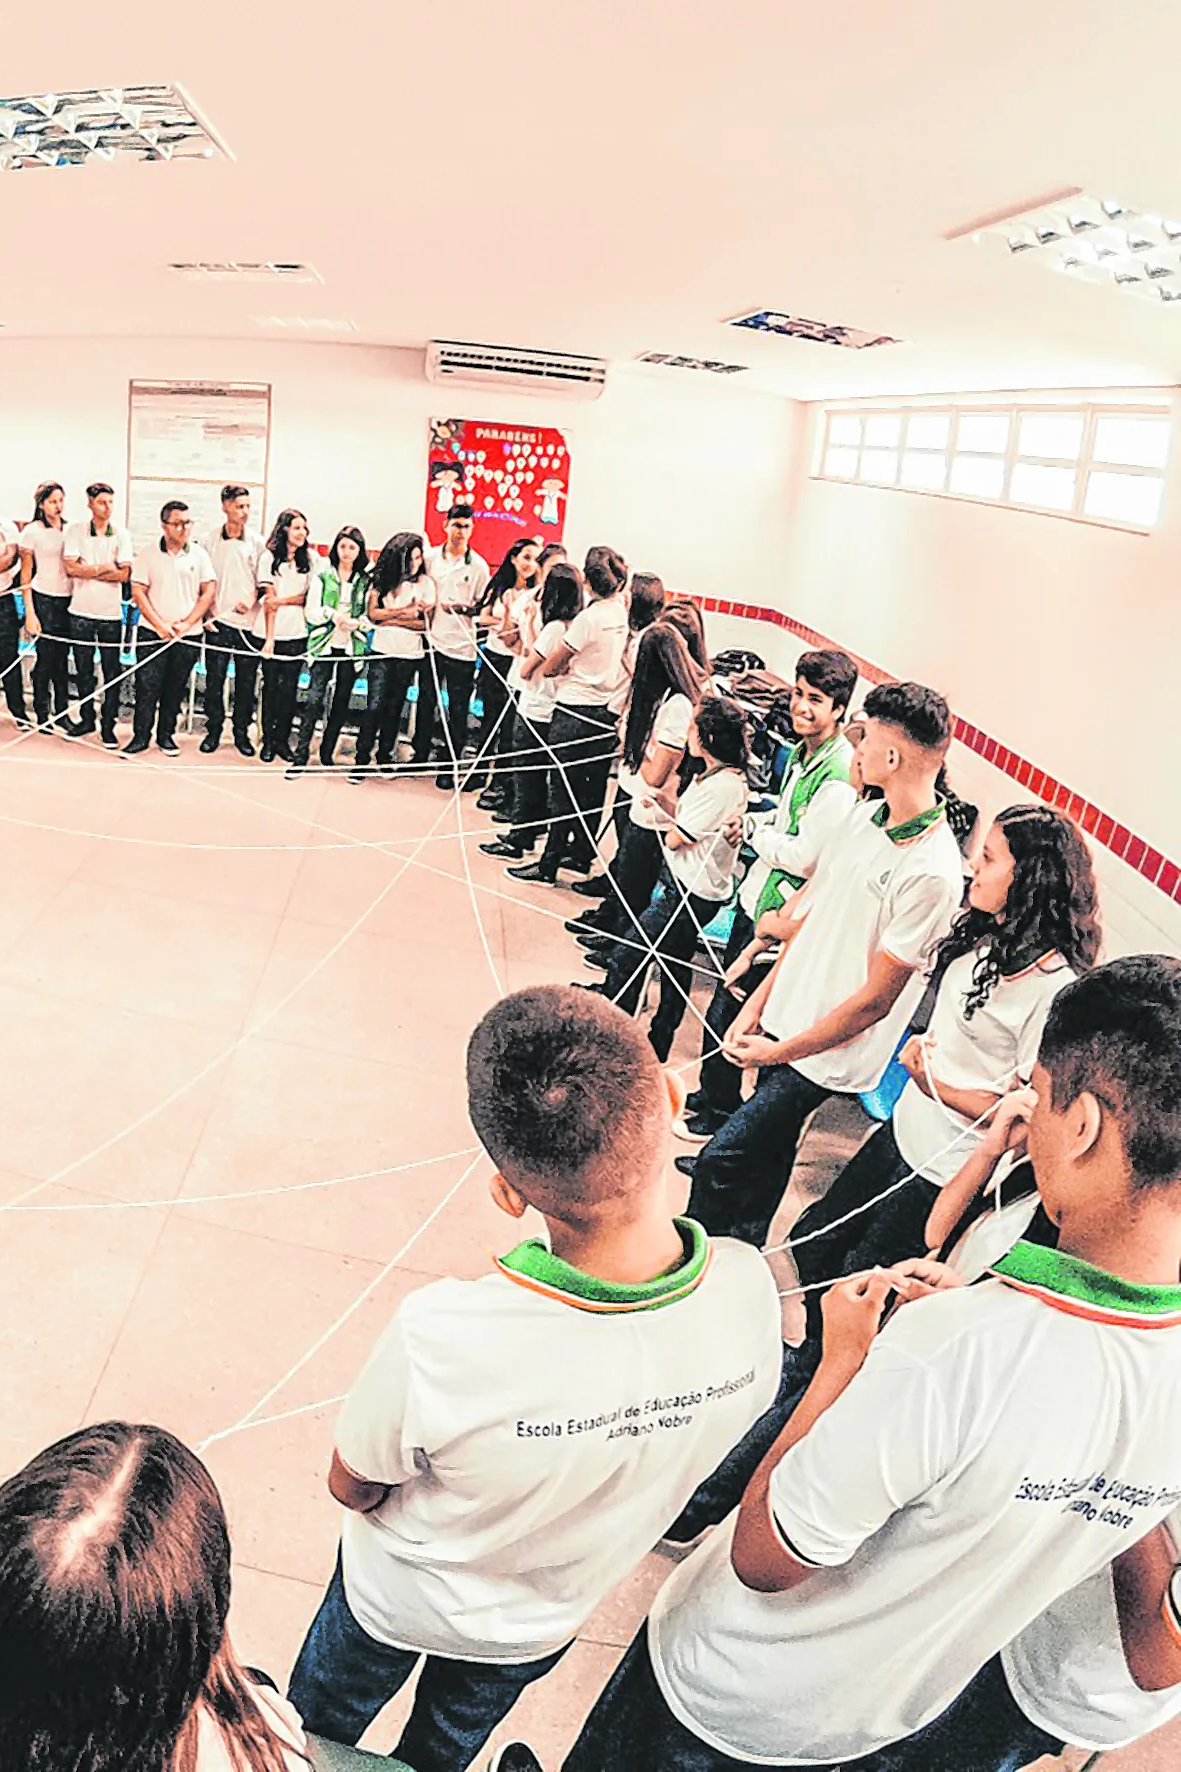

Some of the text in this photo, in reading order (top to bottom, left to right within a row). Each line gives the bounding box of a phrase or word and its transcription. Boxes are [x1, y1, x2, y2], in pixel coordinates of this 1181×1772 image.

[516, 1420, 563, 1438] Escola
[567, 1407, 622, 1436] Estadual
[624, 1405, 641, 1419] de
[644, 1390, 703, 1415] Educação
[605, 1413, 694, 1442] Adriano Nobre
